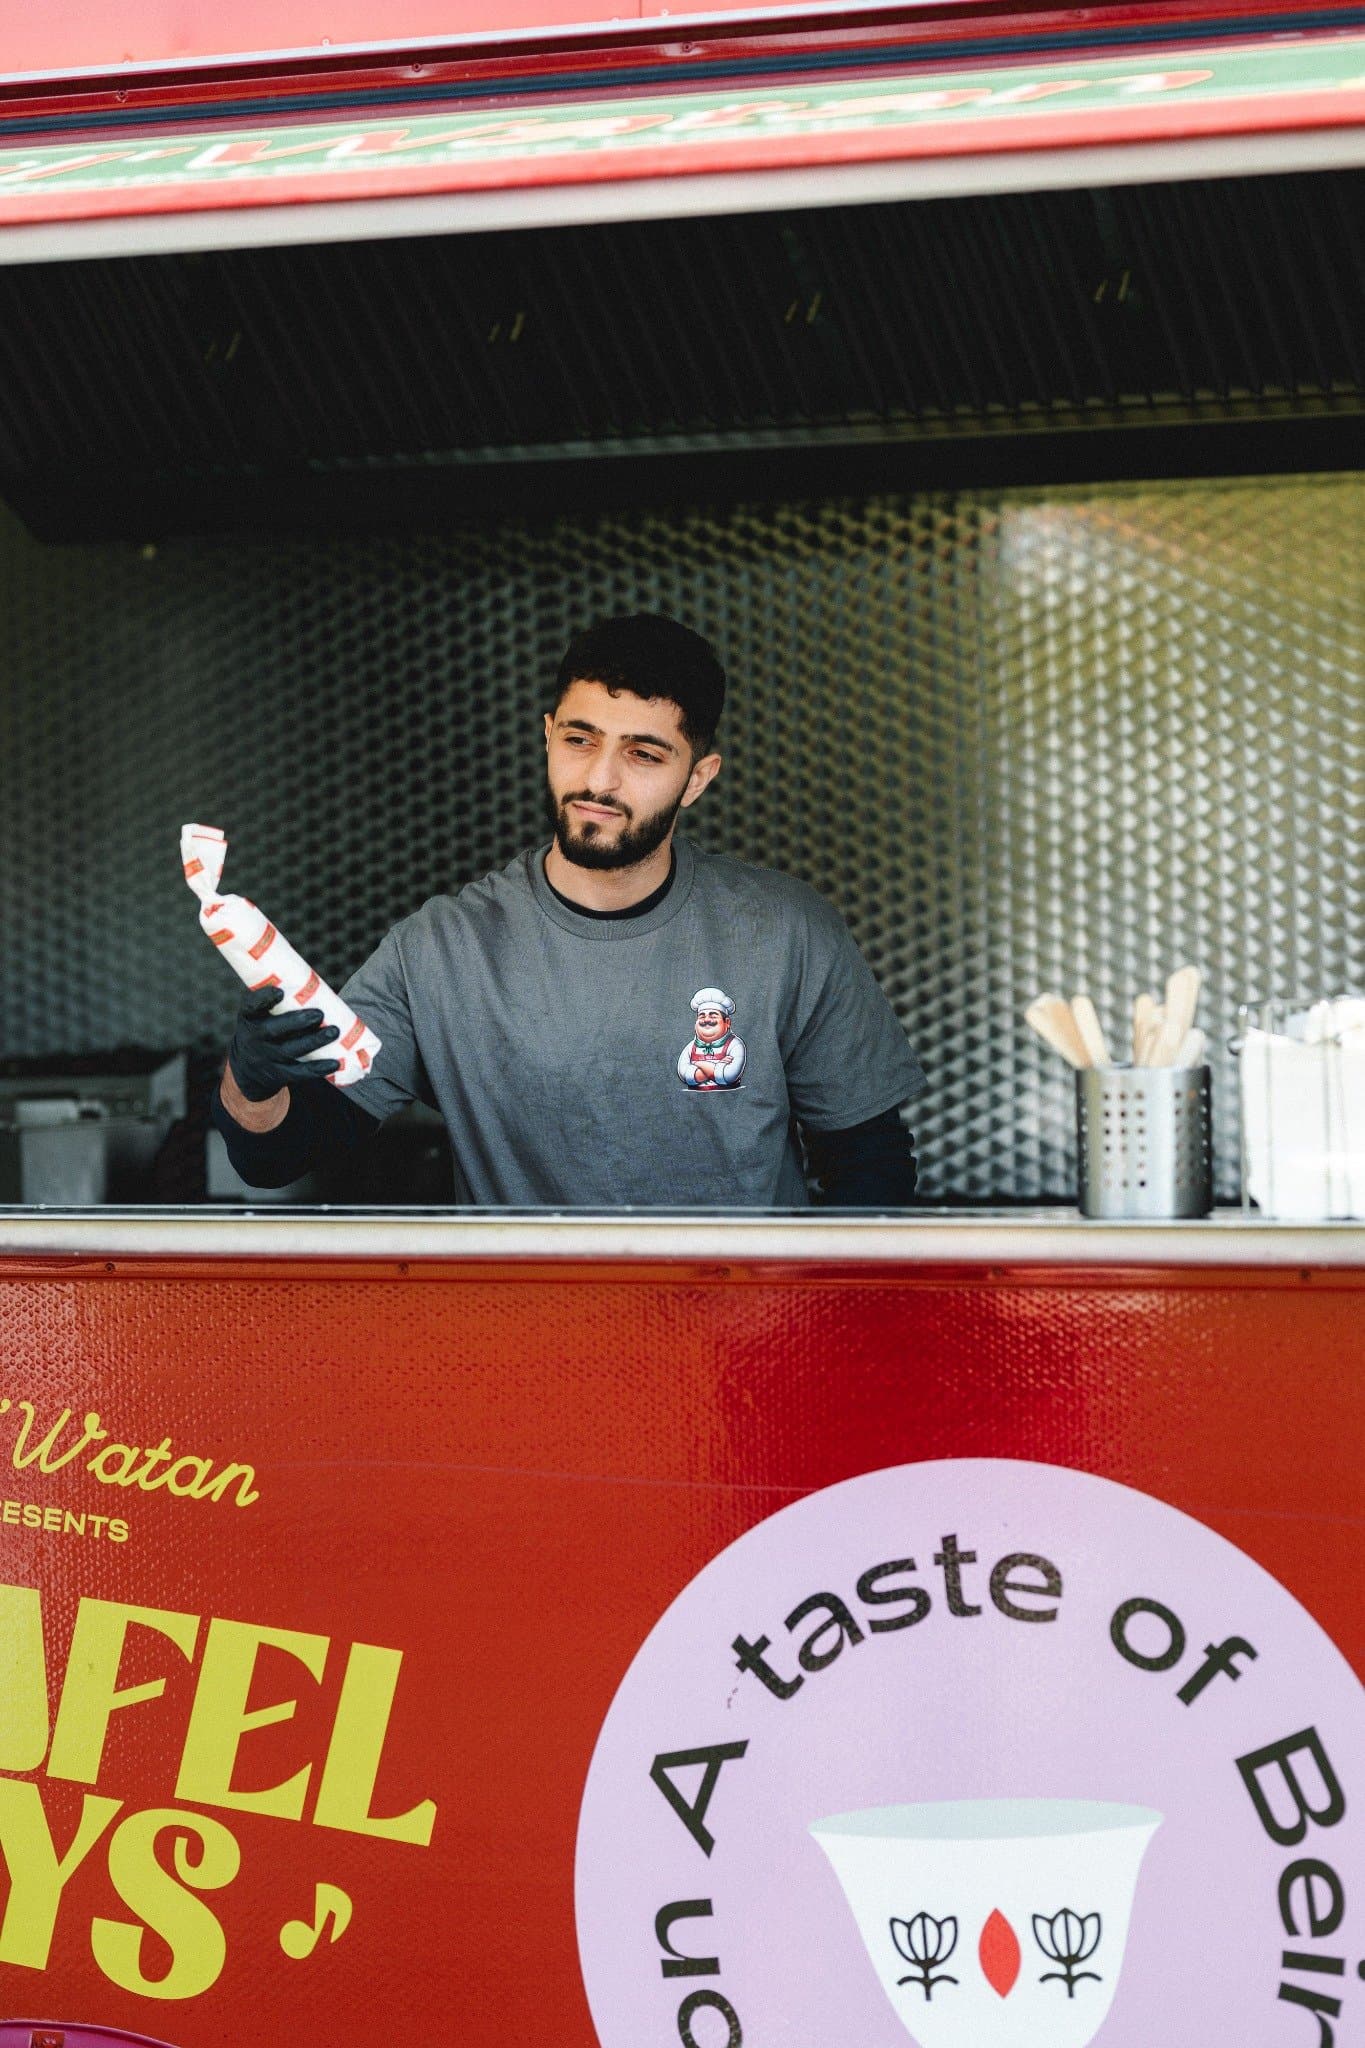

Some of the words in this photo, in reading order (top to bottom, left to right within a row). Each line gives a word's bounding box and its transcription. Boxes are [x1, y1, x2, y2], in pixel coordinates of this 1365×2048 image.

[0, 1500, 129, 1543] ESENTS
[649, 1740, 749, 1858] A
[731, 1534, 1062, 1700] taste
[1110, 1597, 1258, 1706] of
